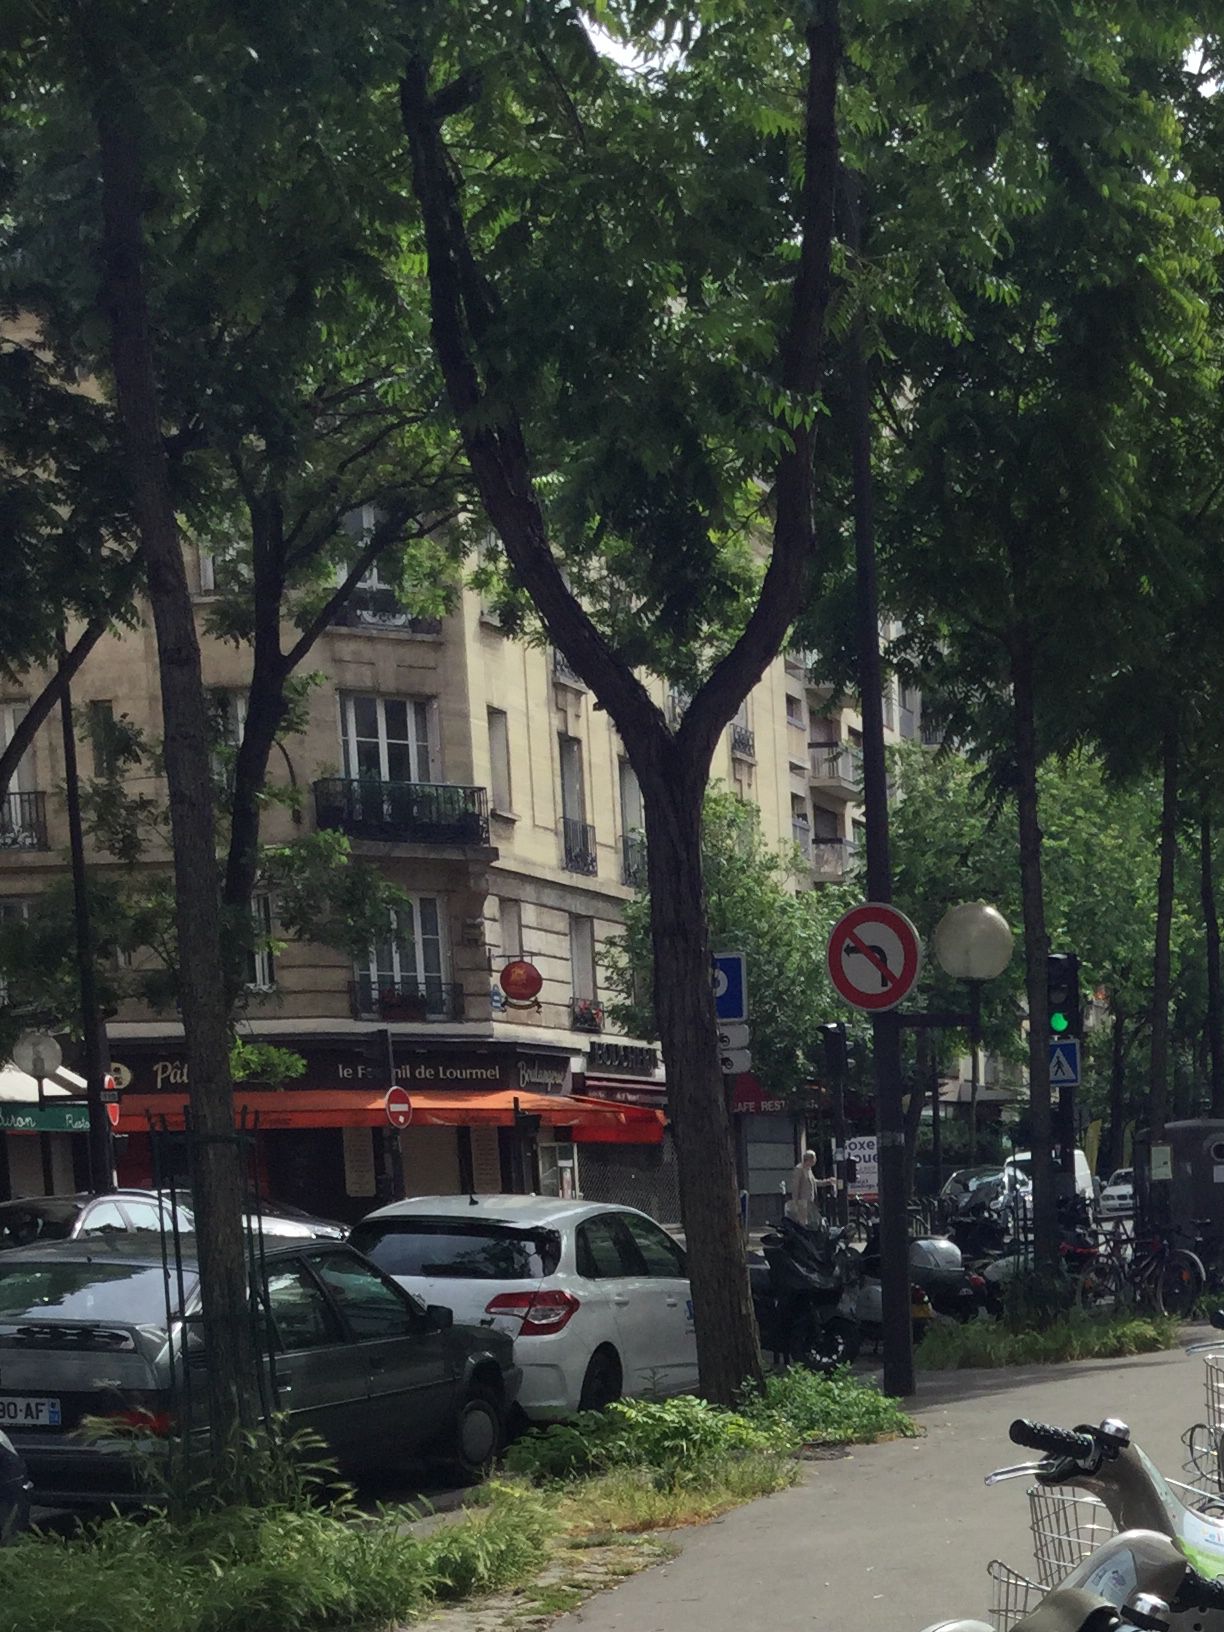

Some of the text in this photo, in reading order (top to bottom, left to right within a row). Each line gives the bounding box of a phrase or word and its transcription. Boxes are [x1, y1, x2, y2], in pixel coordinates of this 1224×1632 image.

[338, 1064, 353, 1079] le
[416, 1064, 435, 1079] de
[440, 1065, 500, 1080] Lourmel
